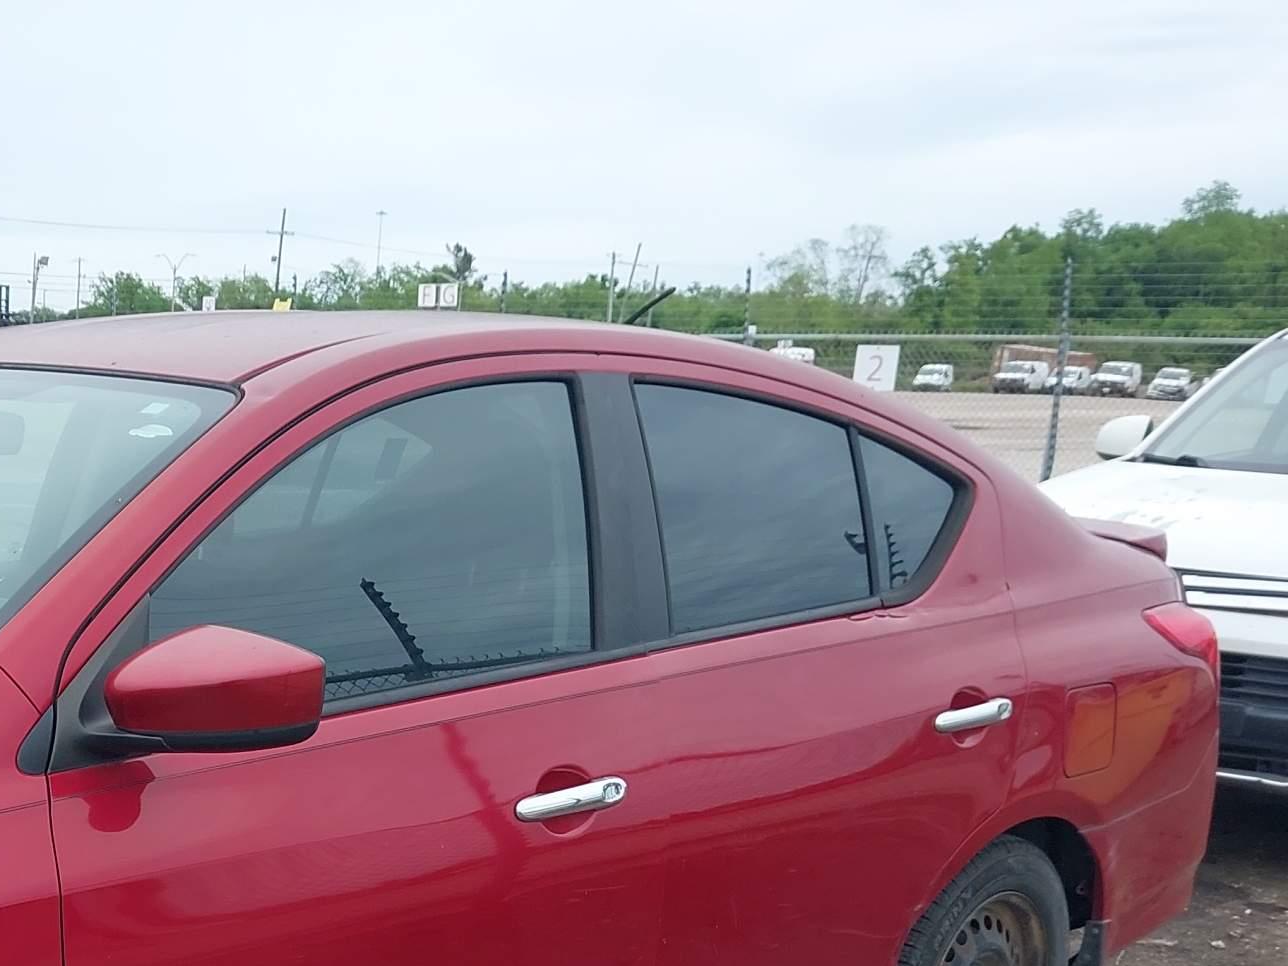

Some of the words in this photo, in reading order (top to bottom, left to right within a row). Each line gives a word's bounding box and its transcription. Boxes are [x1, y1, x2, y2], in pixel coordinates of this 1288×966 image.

[422, 285, 432, 305] F
[442, 285, 455, 305] G
[866, 355, 884, 382] 2
